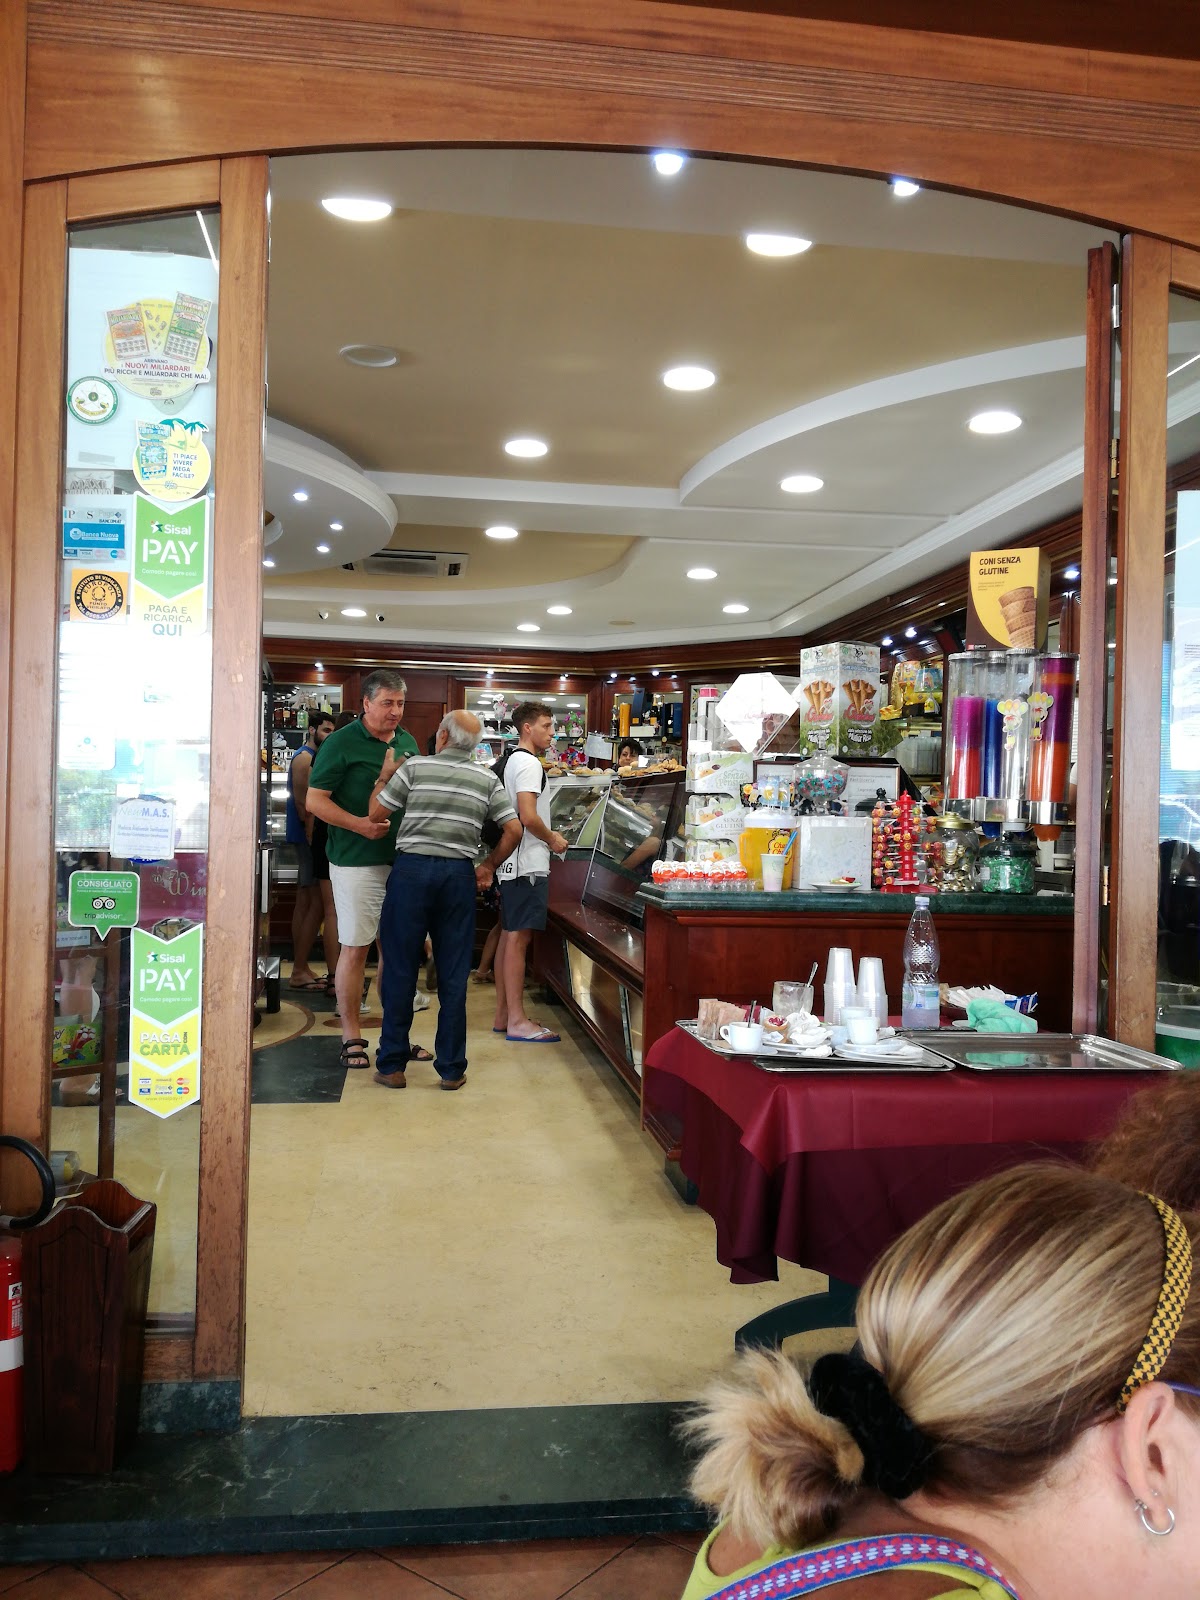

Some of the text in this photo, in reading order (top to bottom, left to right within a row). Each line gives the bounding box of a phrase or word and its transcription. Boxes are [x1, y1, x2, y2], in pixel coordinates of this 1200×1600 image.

[150, 364, 190, 372] MILIARDARI
[164, 524, 191, 535] Sisal
[142, 539, 199, 565] PAY
[979, 556, 1022, 566] CONI SENZA
[978, 567, 1010, 576] GLUTINE
[82, 580, 115, 596] EUROPOL
[148, 604, 188, 615] PAGA E
[143, 613, 193, 623] RICARICA
[152, 623, 183, 637] QUI
[141, 808, 170, 818] M.A.S.
[77, 879, 133, 889] CONSIGLIATO
[84, 912, 121, 920] tripadvisor
[159, 953, 185, 964] Sisal
[139, 968, 193, 992] PAY
[140, 1032, 182, 1044] PAGA
[139, 1043, 191, 1056] CARTA
